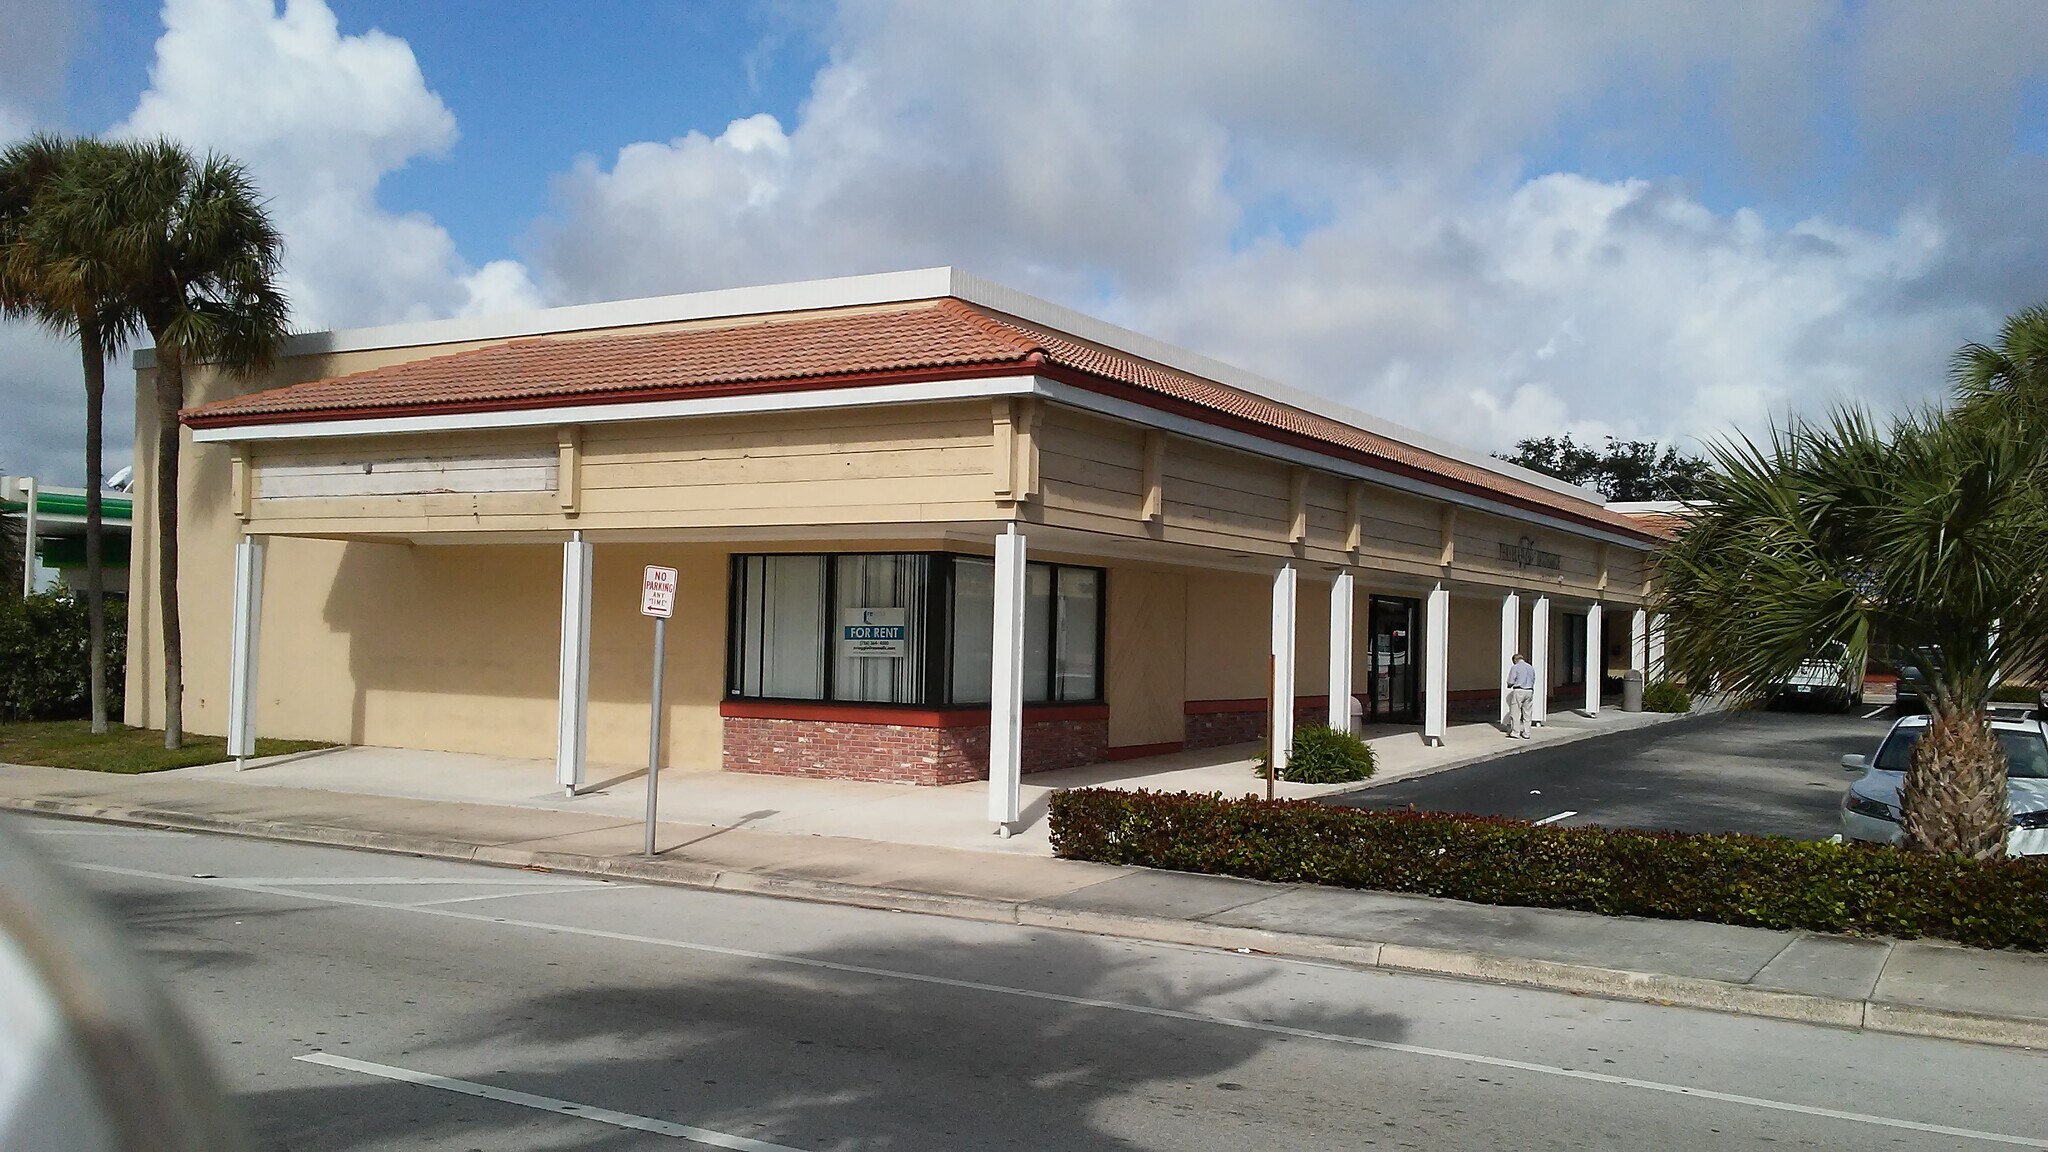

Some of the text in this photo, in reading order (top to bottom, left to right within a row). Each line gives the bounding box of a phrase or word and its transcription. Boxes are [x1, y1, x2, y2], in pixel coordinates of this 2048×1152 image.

[655, 571, 667, 581] NO
[646, 580, 673, 593] PARKING
[850, 627, 898, 638] FOR RENT
